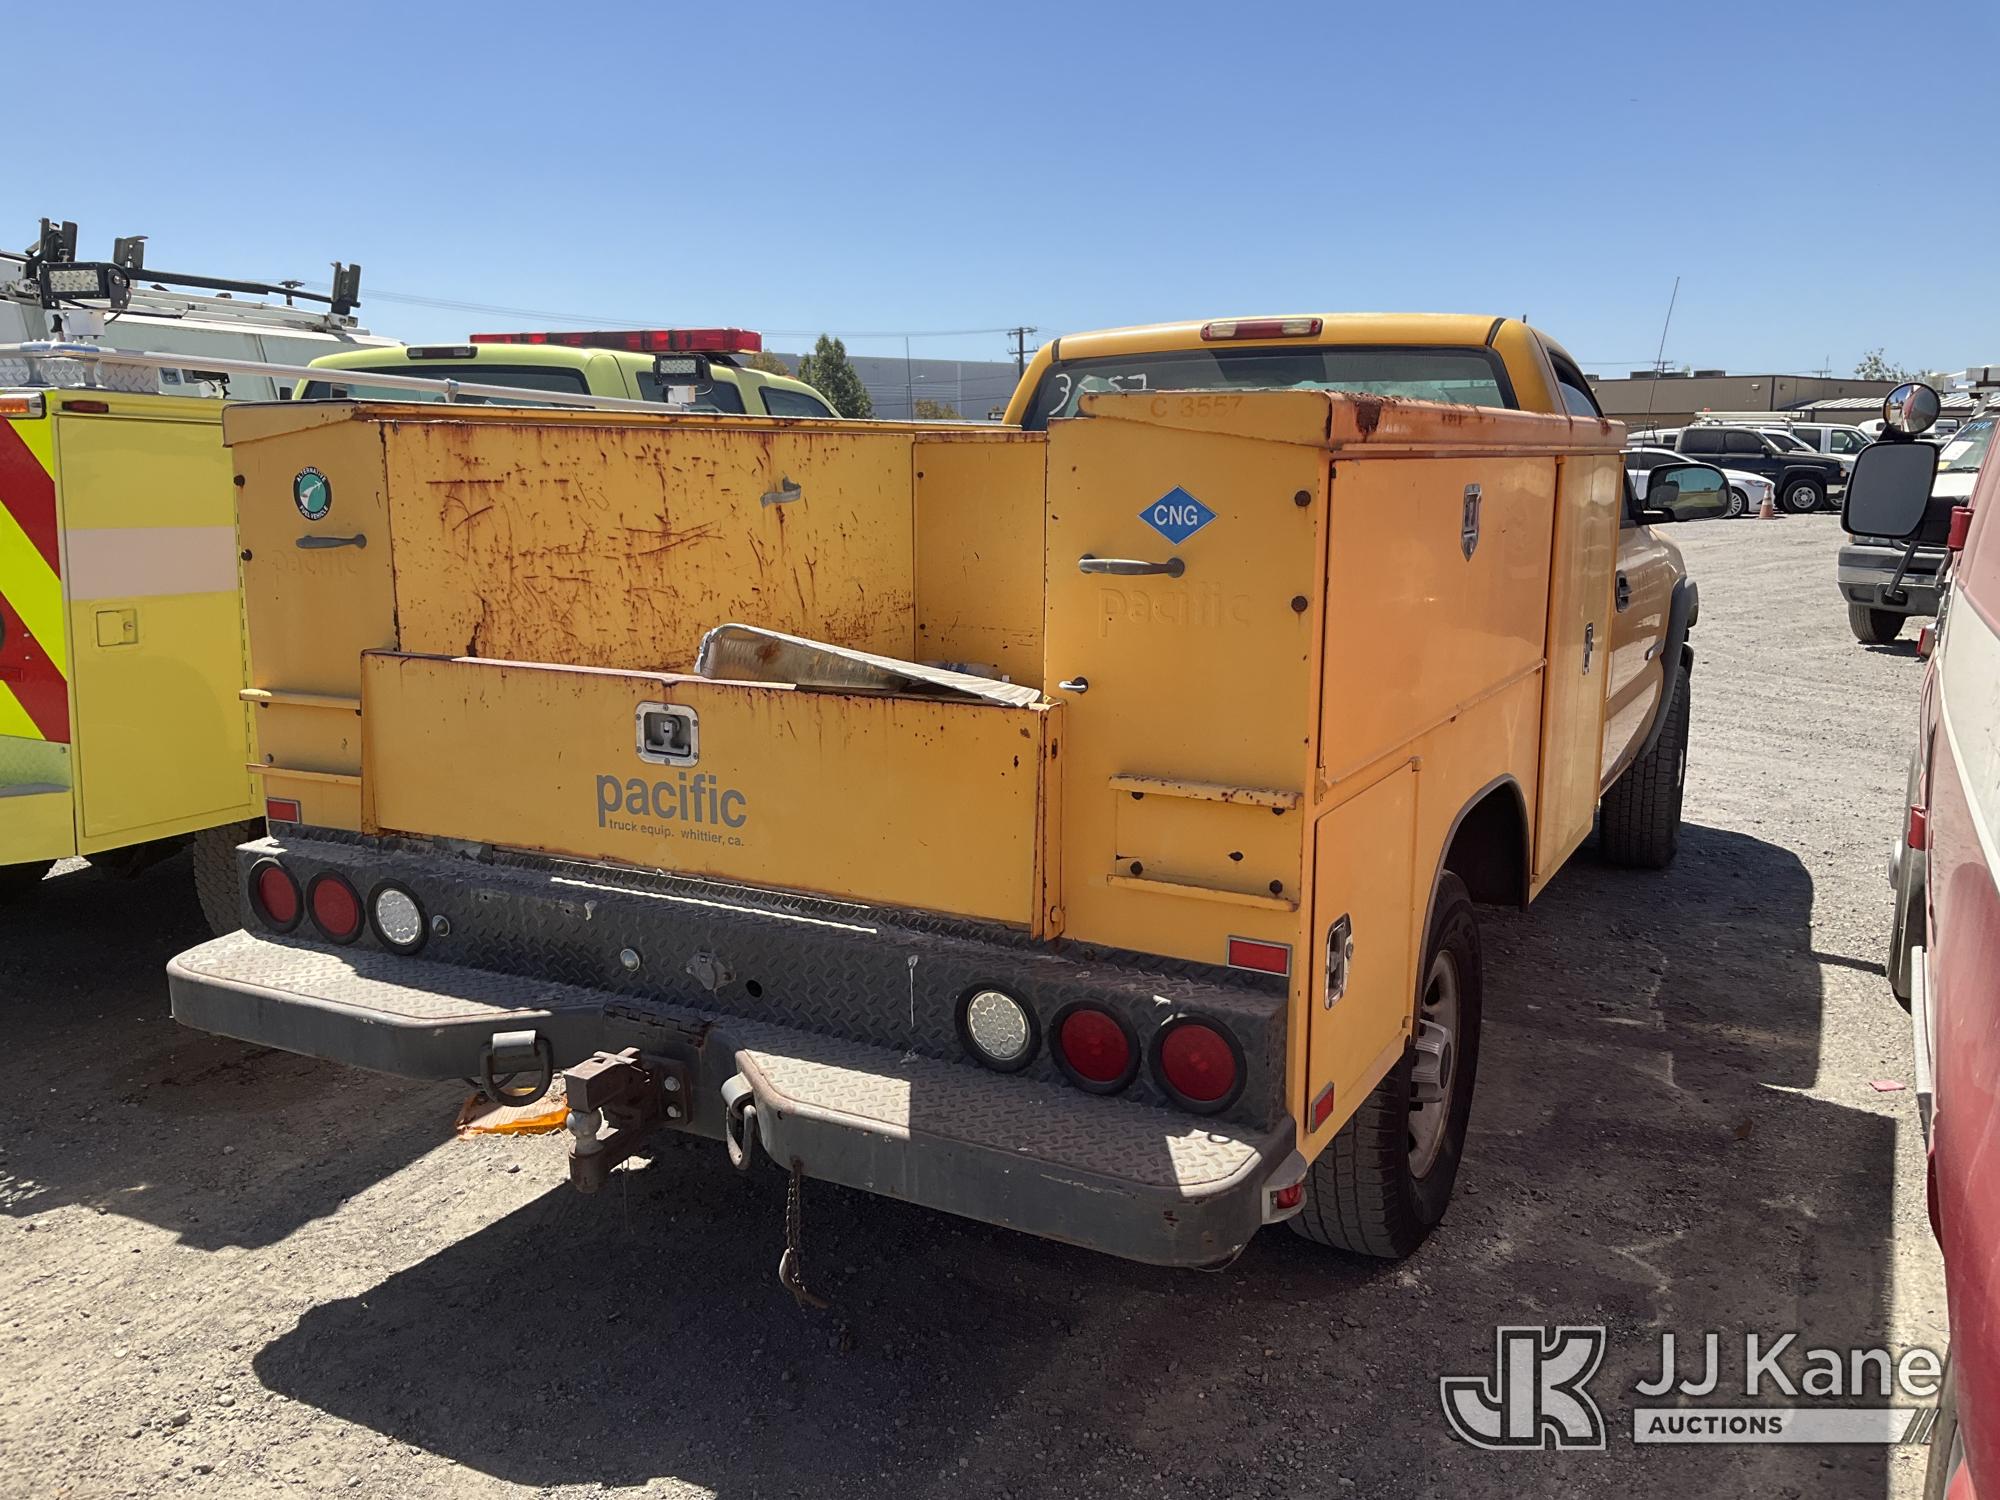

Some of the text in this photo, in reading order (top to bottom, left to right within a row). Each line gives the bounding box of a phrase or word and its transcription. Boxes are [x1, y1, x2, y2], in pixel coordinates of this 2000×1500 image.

[1151, 395, 1244, 418] C 3557
[1153, 504, 1198, 526] CNG
[1097, 578, 1253, 639] pacific
[596, 771, 747, 828] pacific
[609, 818, 744, 847] truck equip. whittier, ca.
